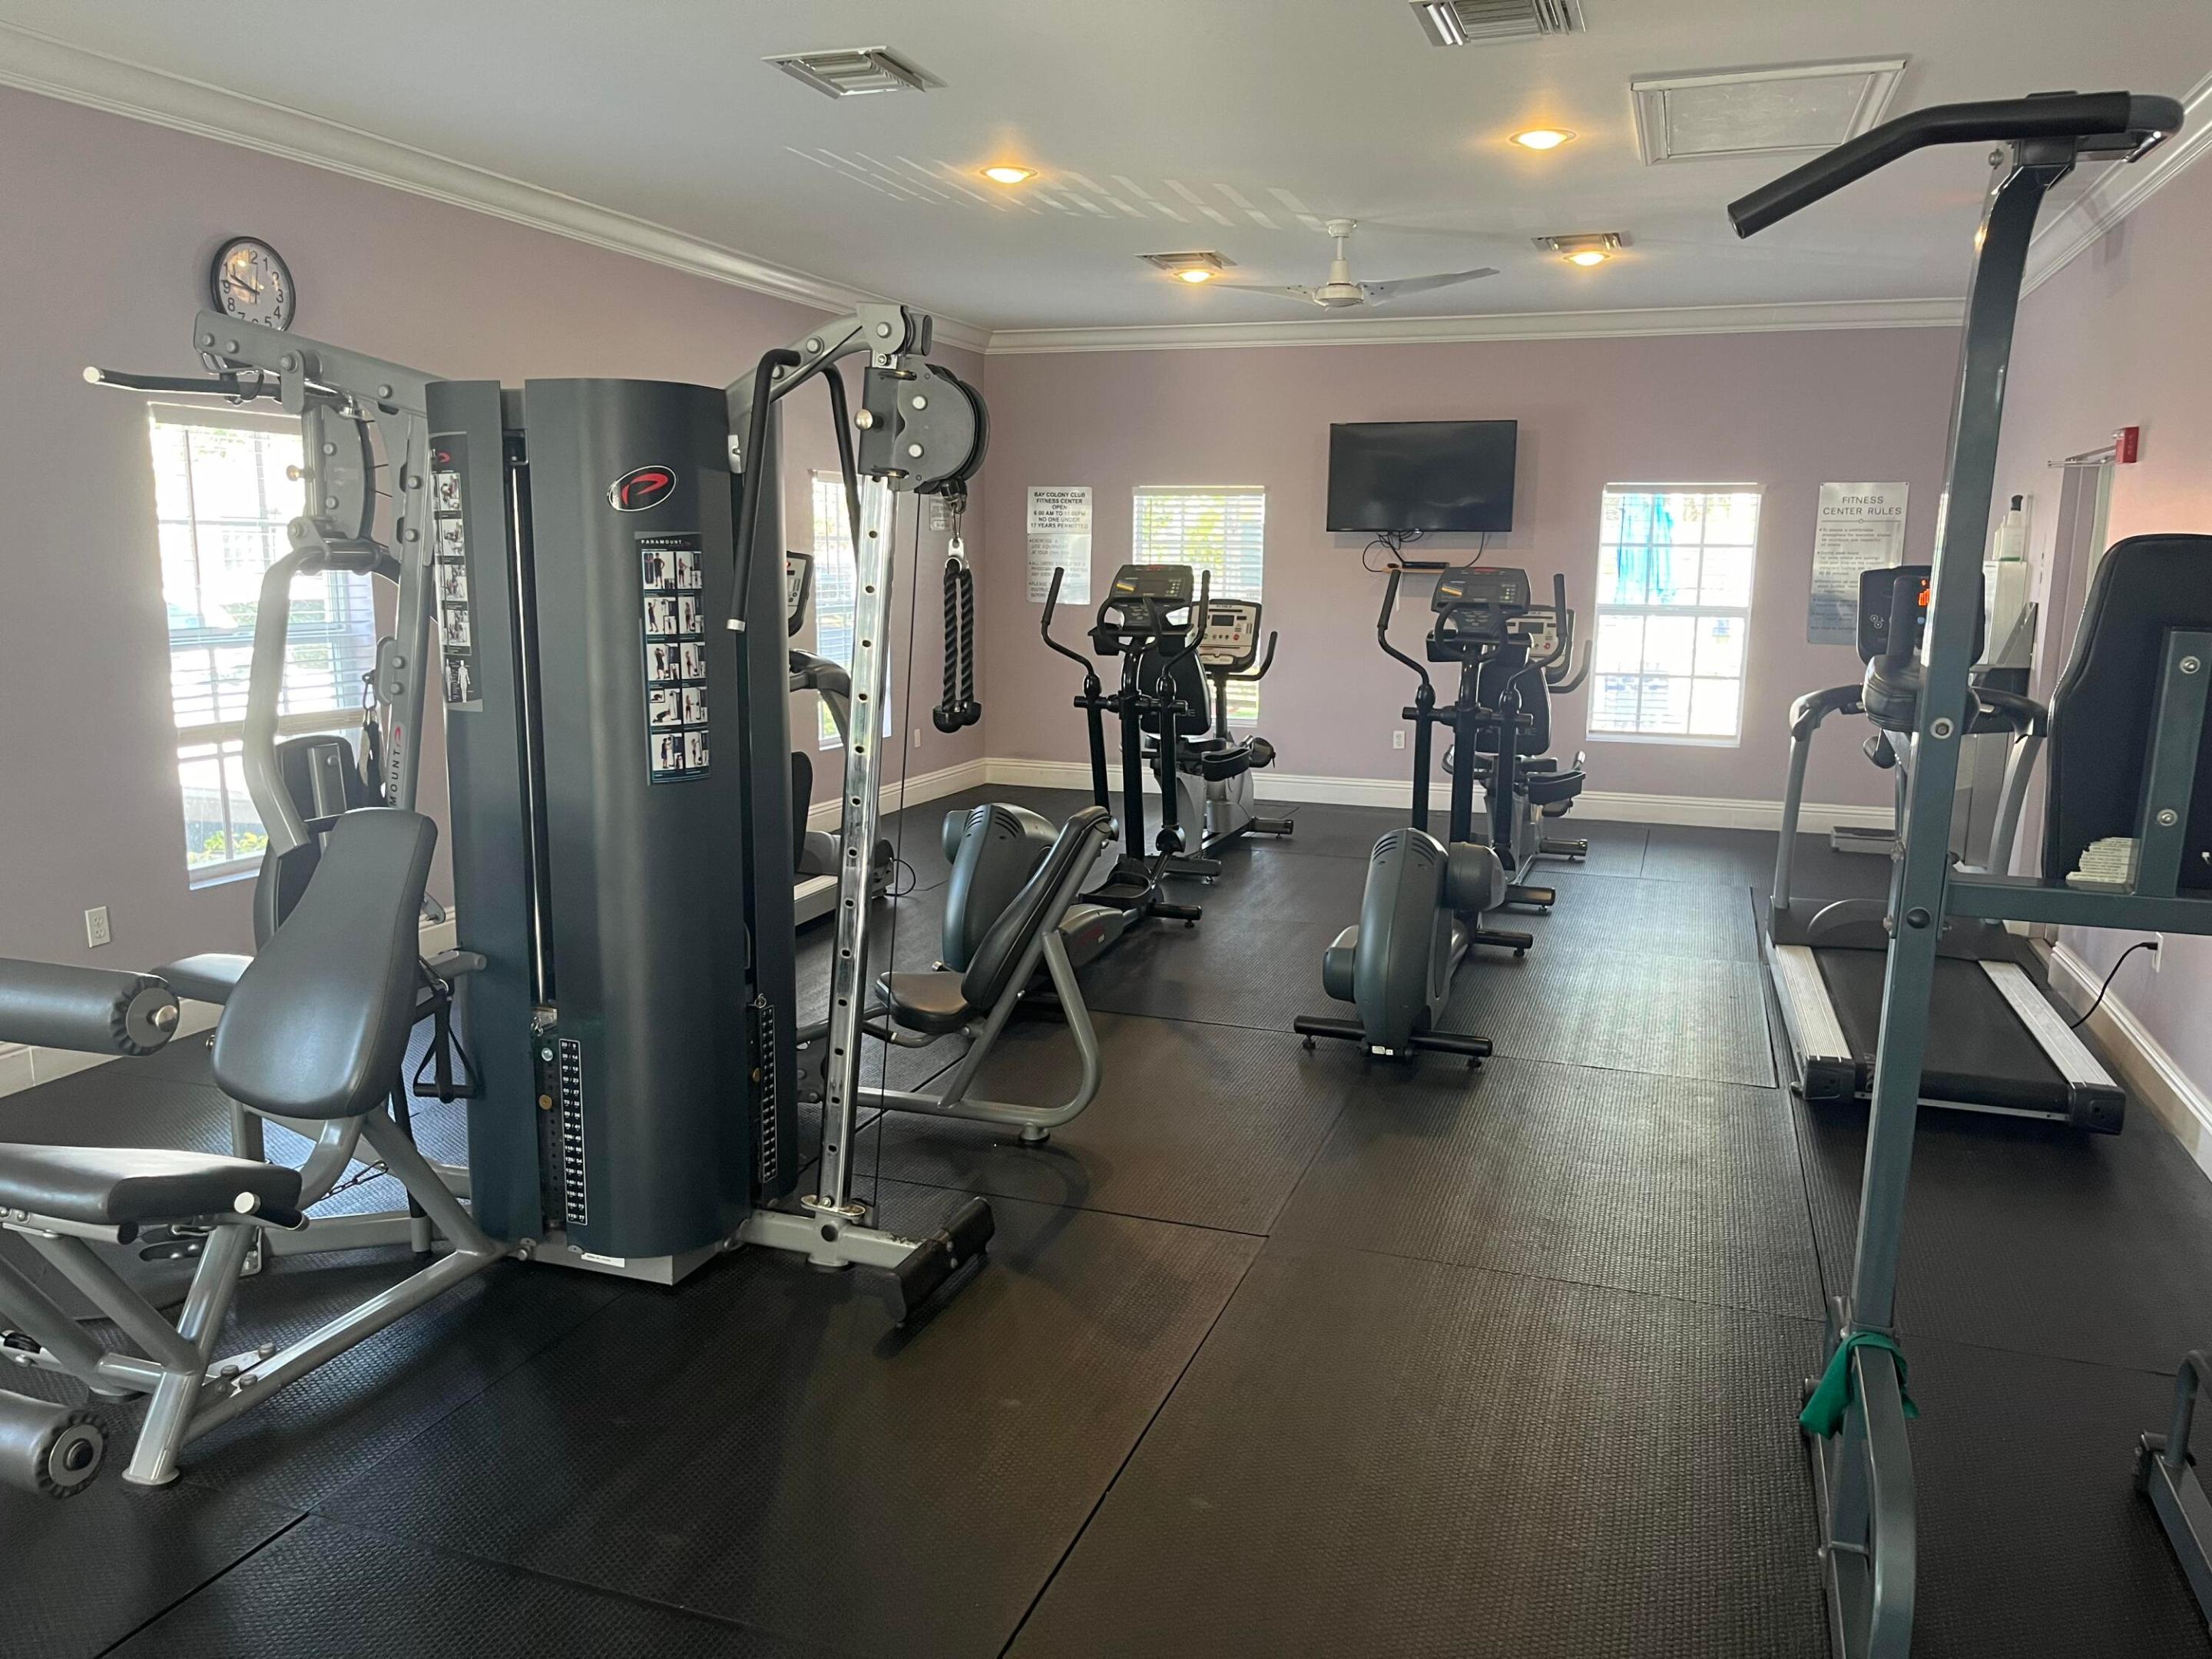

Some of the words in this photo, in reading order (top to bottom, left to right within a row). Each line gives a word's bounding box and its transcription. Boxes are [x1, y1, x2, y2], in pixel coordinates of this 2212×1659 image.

[276, 289, 284, 303] 3
[227, 297, 235, 312] 8
[273, 306, 281, 320] 4
[1823, 507, 1863, 515] CENTER
[1867, 507, 1902, 515] RULES
